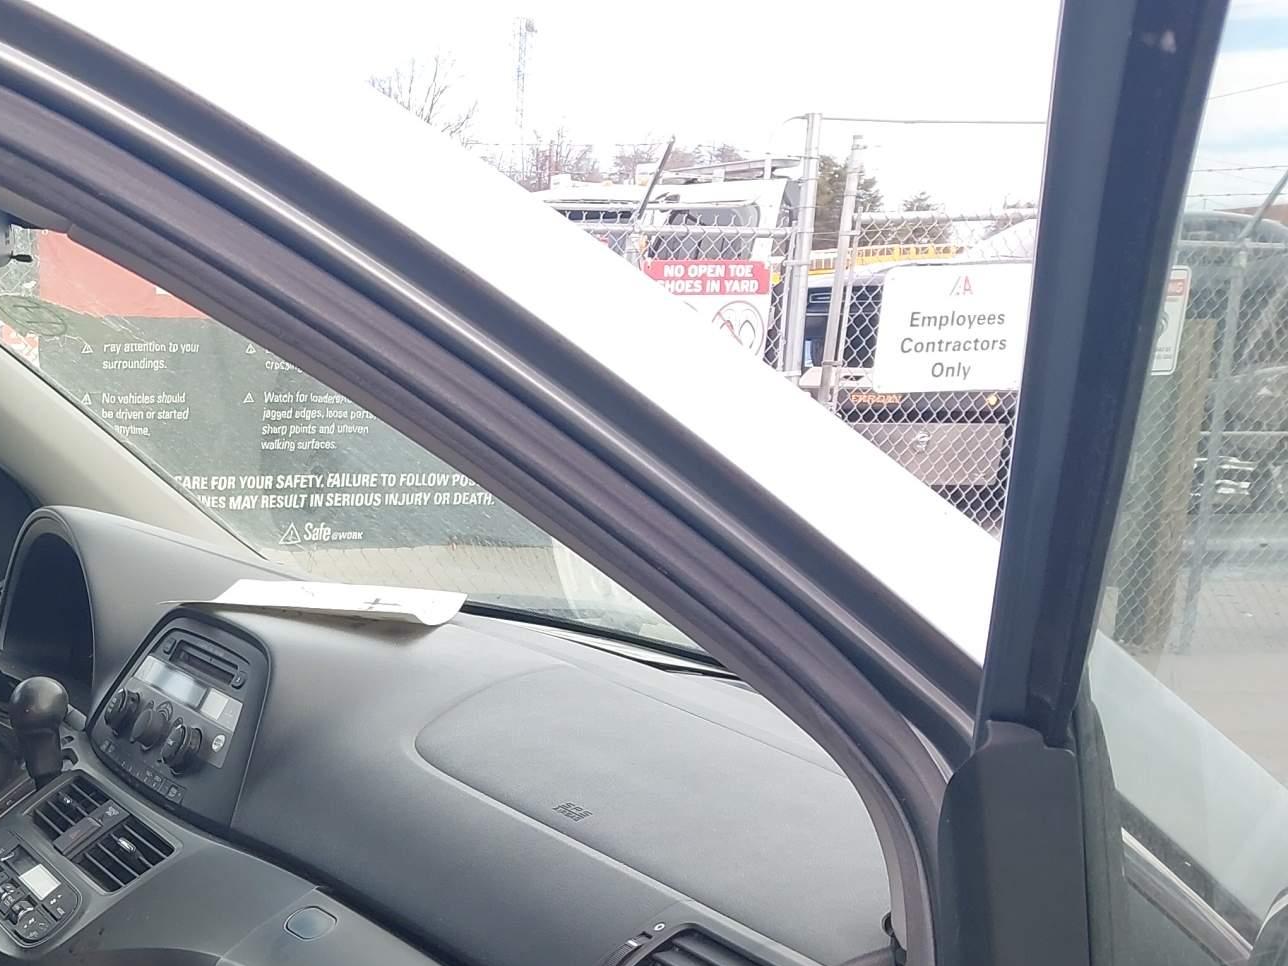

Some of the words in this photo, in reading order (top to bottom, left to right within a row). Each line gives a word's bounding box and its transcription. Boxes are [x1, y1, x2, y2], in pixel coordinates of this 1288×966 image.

[663, 264, 684, 277] NO
[687, 264, 725, 277] OPEN
[728, 264, 754, 277] TOE
[661, 279, 703, 293] HOES
[706, 279, 721, 293] IN
[724, 279, 759, 293] YARD
[909, 310, 1006, 331] Employees
[124, 341, 166, 353] attention
[169, 342, 178, 352] to
[181, 343, 199, 354] your
[900, 337, 1007, 353] Contractors
[102, 357, 167, 371] surroundings.
[931, 362, 972, 381] Only
[102, 392, 116, 404] No
[118, 392, 155, 404] vehicles
[157, 391, 185, 403] should
[264, 391, 293, 404] Watch
[296, 391, 308, 403] for
[101, 408, 113, 419] be
[116, 408, 143, 420] driven
[146, 411, 155, 419] or
[158, 407, 189, 420] started
[263, 407, 292, 421] jagged
[326, 407, 348, 419] loose
[262, 423, 287, 436] sharp
[289, 423, 316, 437] points
[319, 422, 334, 434] and
[337, 424, 369, 434] uneven
[261, 439, 295, 452] walking
[297, 439, 337, 450] surfaces.
[211, 475, 236, 490] FOR
[239, 475, 273, 489] YOUR
[275, 474, 324, 488] SAFETY.
[327, 472, 378, 488] FAILURE
[381, 473, 396, 487] TO
[399, 473, 449, 487] FOLLOW
[229, 496, 258, 510] MAY
[261, 494, 308, 509] RESULT
[310, 493, 323, 507] IN
[325, 492, 382, 507] SERIOUS
[385, 492, 432, 506] INJURY
[434, 492, 451, 505] OR
[453, 491, 495, 505] DEATH.
